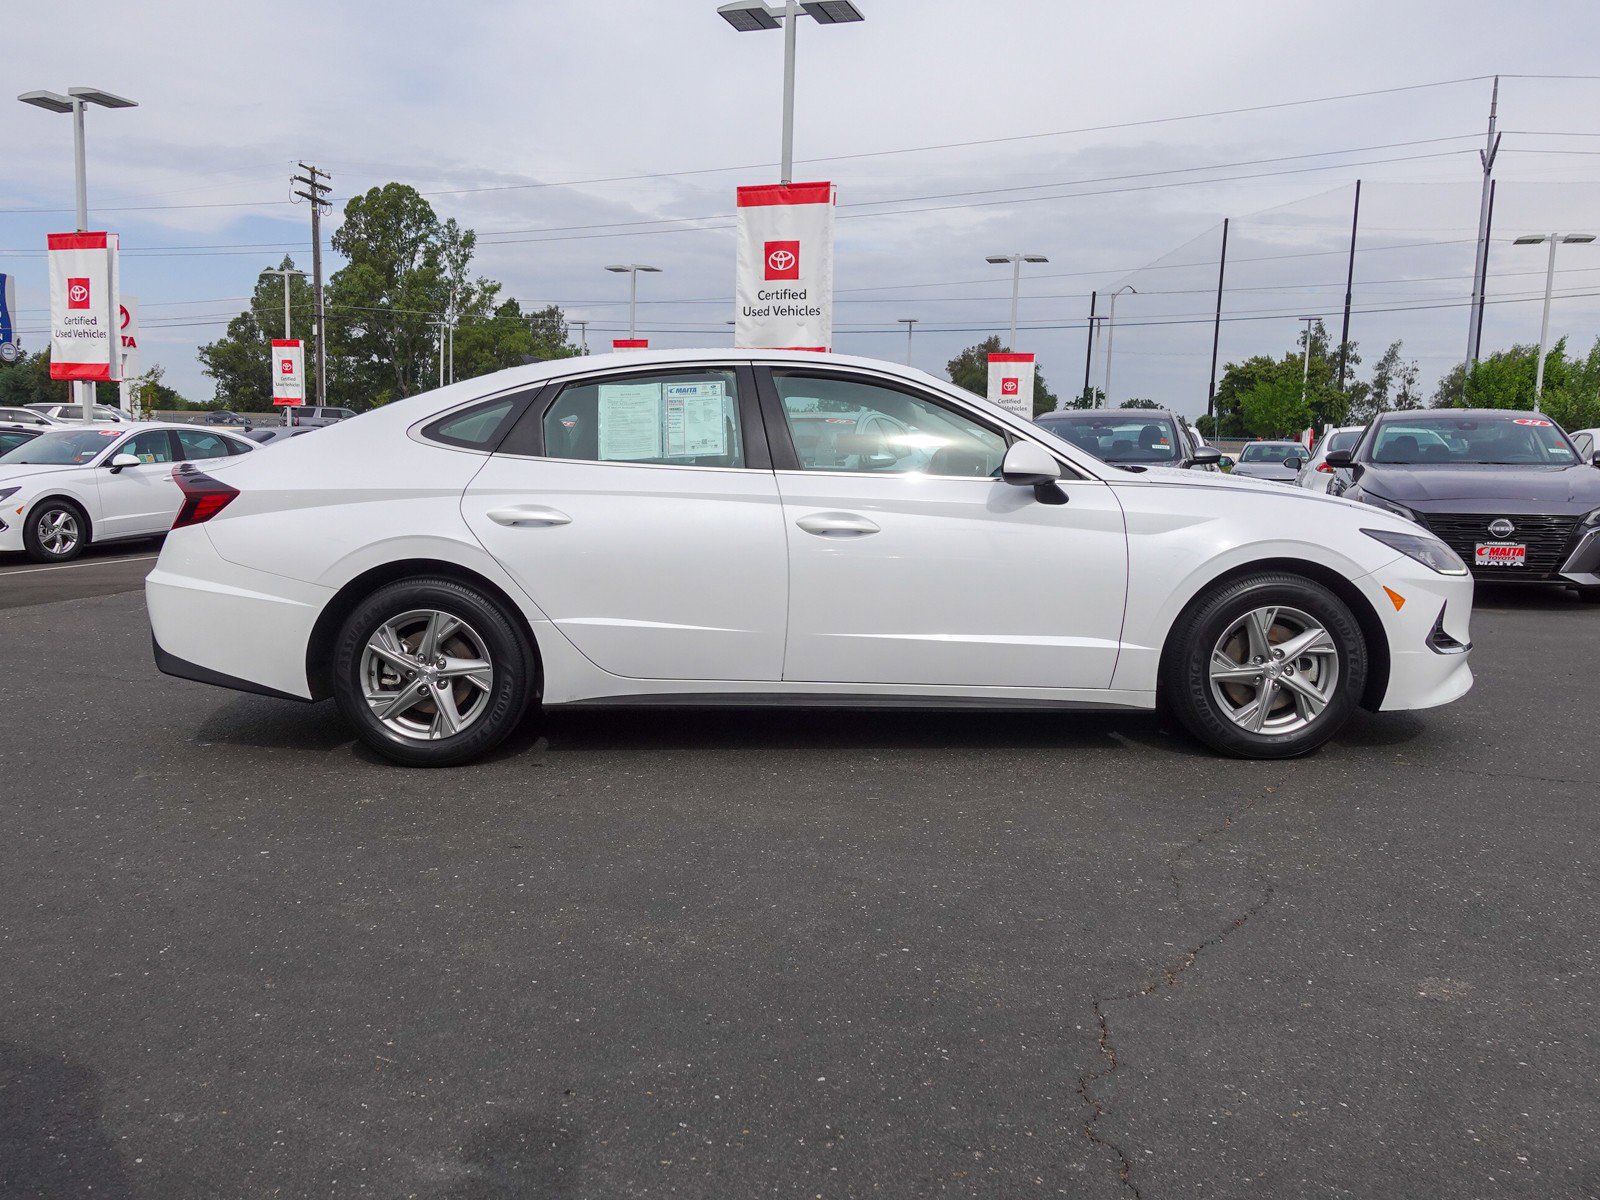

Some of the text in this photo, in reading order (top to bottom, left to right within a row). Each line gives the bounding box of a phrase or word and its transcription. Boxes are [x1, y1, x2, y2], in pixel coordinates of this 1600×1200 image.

[758, 288, 807, 301] Certified
[743, 304, 821, 317] Used Vehicles
[64, 316, 98, 326] Certified
[55, 329, 107, 339] Used Vehicles
[1489, 547, 1525, 557] MAITA
